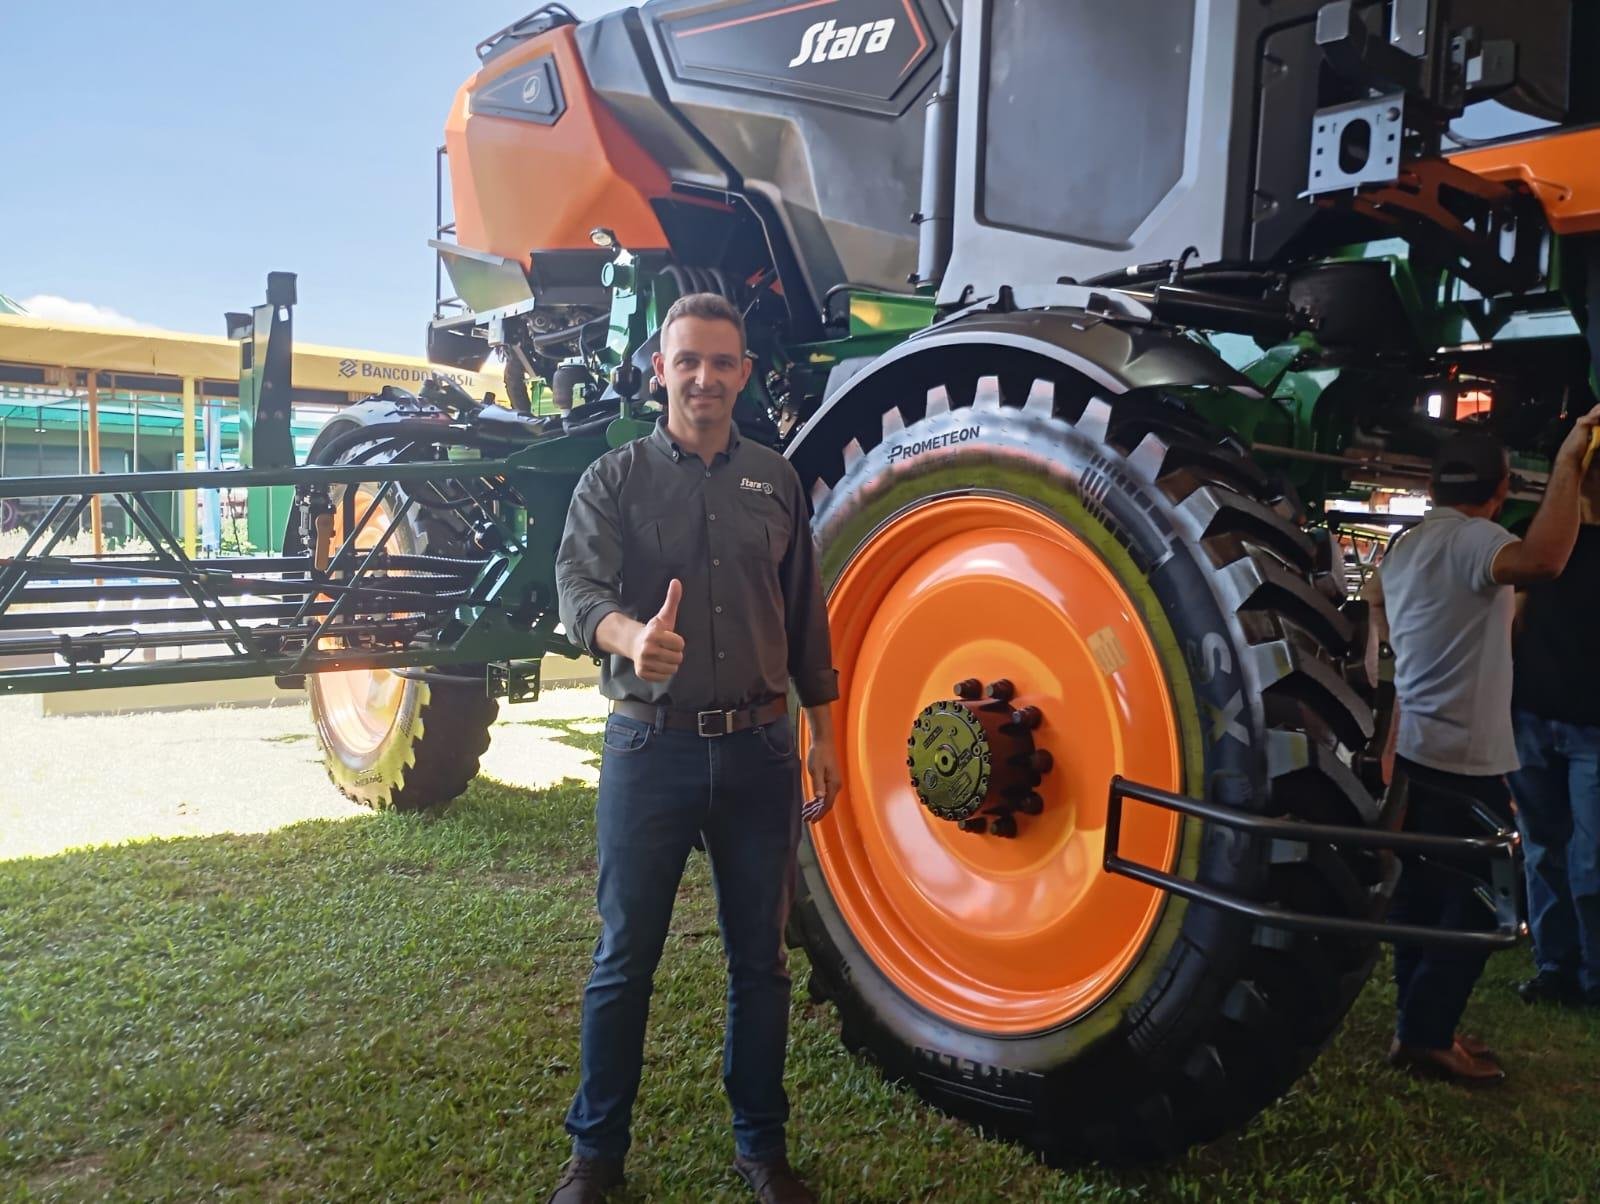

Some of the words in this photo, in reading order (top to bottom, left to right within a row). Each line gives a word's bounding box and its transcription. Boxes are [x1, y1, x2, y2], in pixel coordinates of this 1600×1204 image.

[789, 18, 895, 68] Stara
[361, 362, 409, 381] BANCO
[887, 426, 980, 464] PROMETEON
[740, 477, 762, 489] Stara
